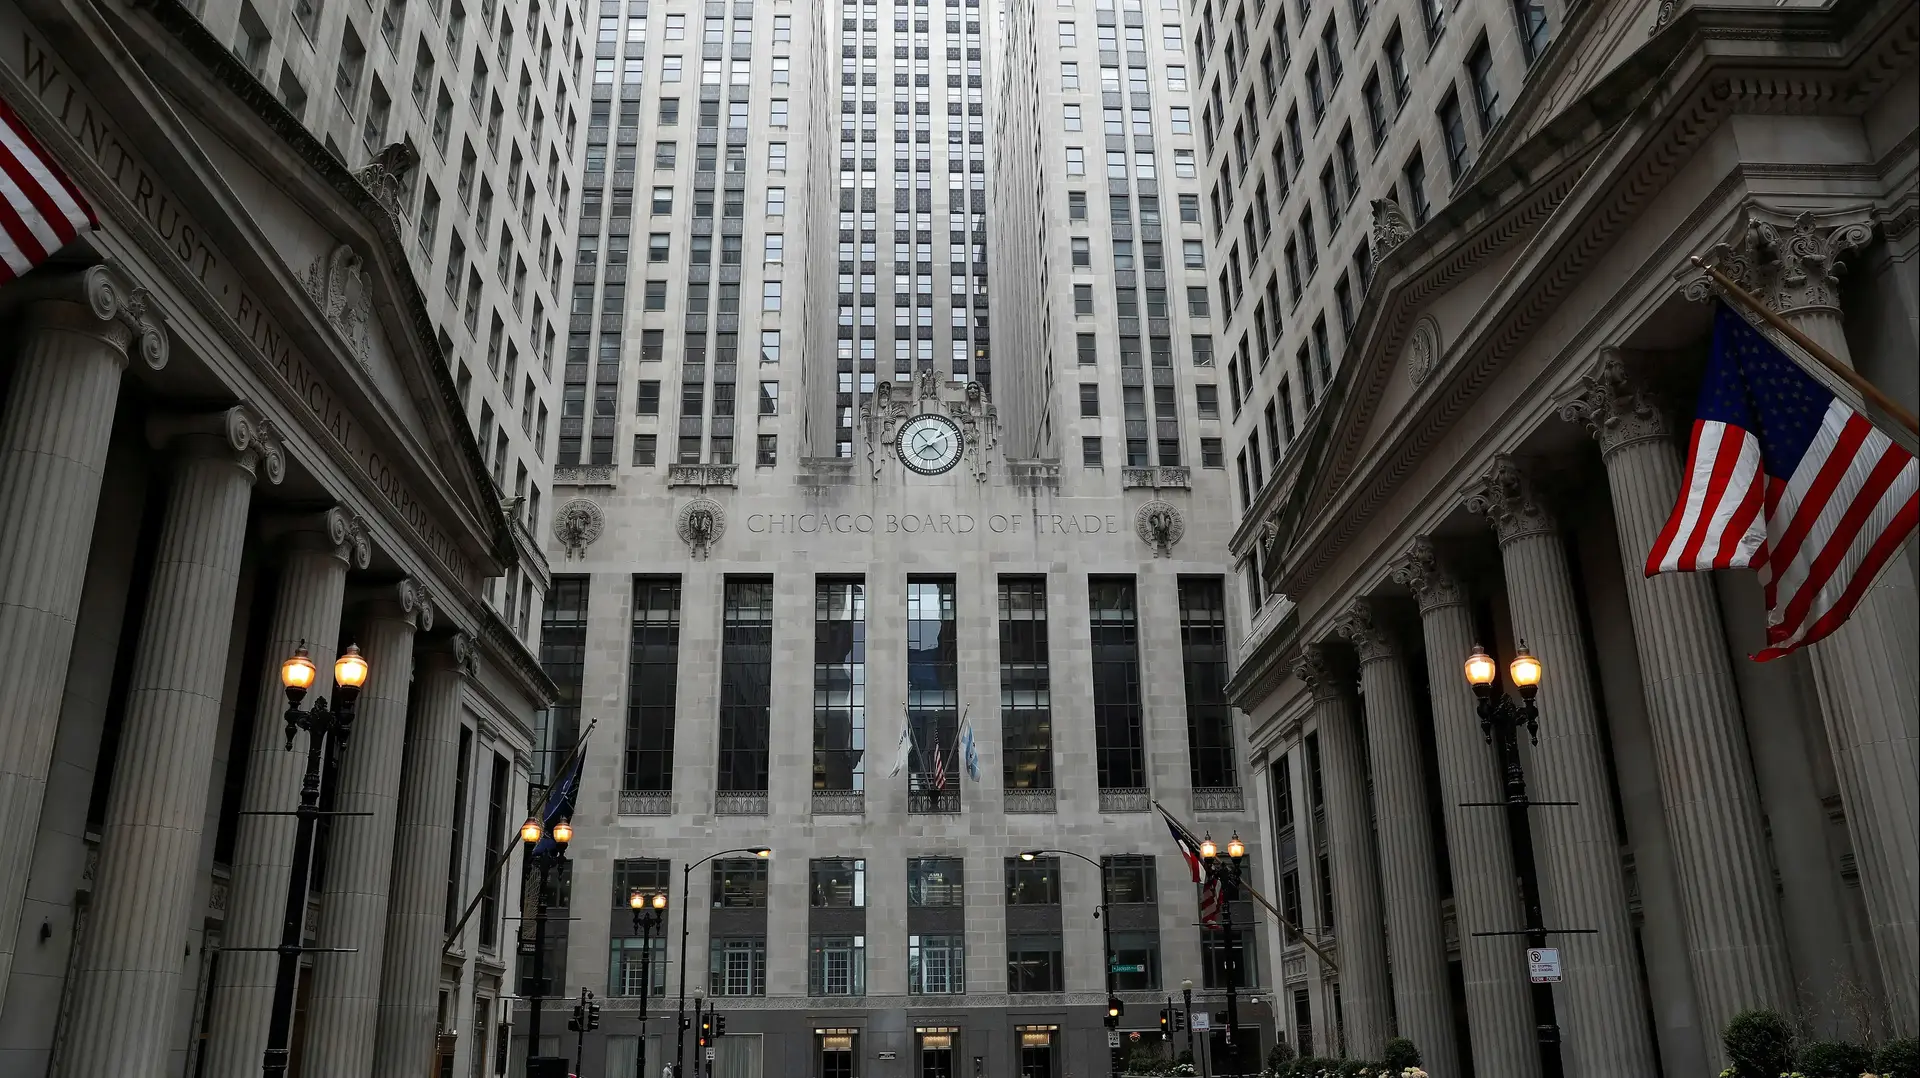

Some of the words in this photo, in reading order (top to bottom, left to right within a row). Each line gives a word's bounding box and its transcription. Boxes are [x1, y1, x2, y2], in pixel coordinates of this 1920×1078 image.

[23, 32, 216, 284] WINTRUST
[234, 290, 354, 455] FINANCIAL
[368, 453, 467, 582] CORPORATION
[747, 513, 874, 534] CHICAGO
[884, 513, 975, 534] BOARD
[988, 514, 1022, 534] OF
[1034, 514, 1118, 534] TRADE
